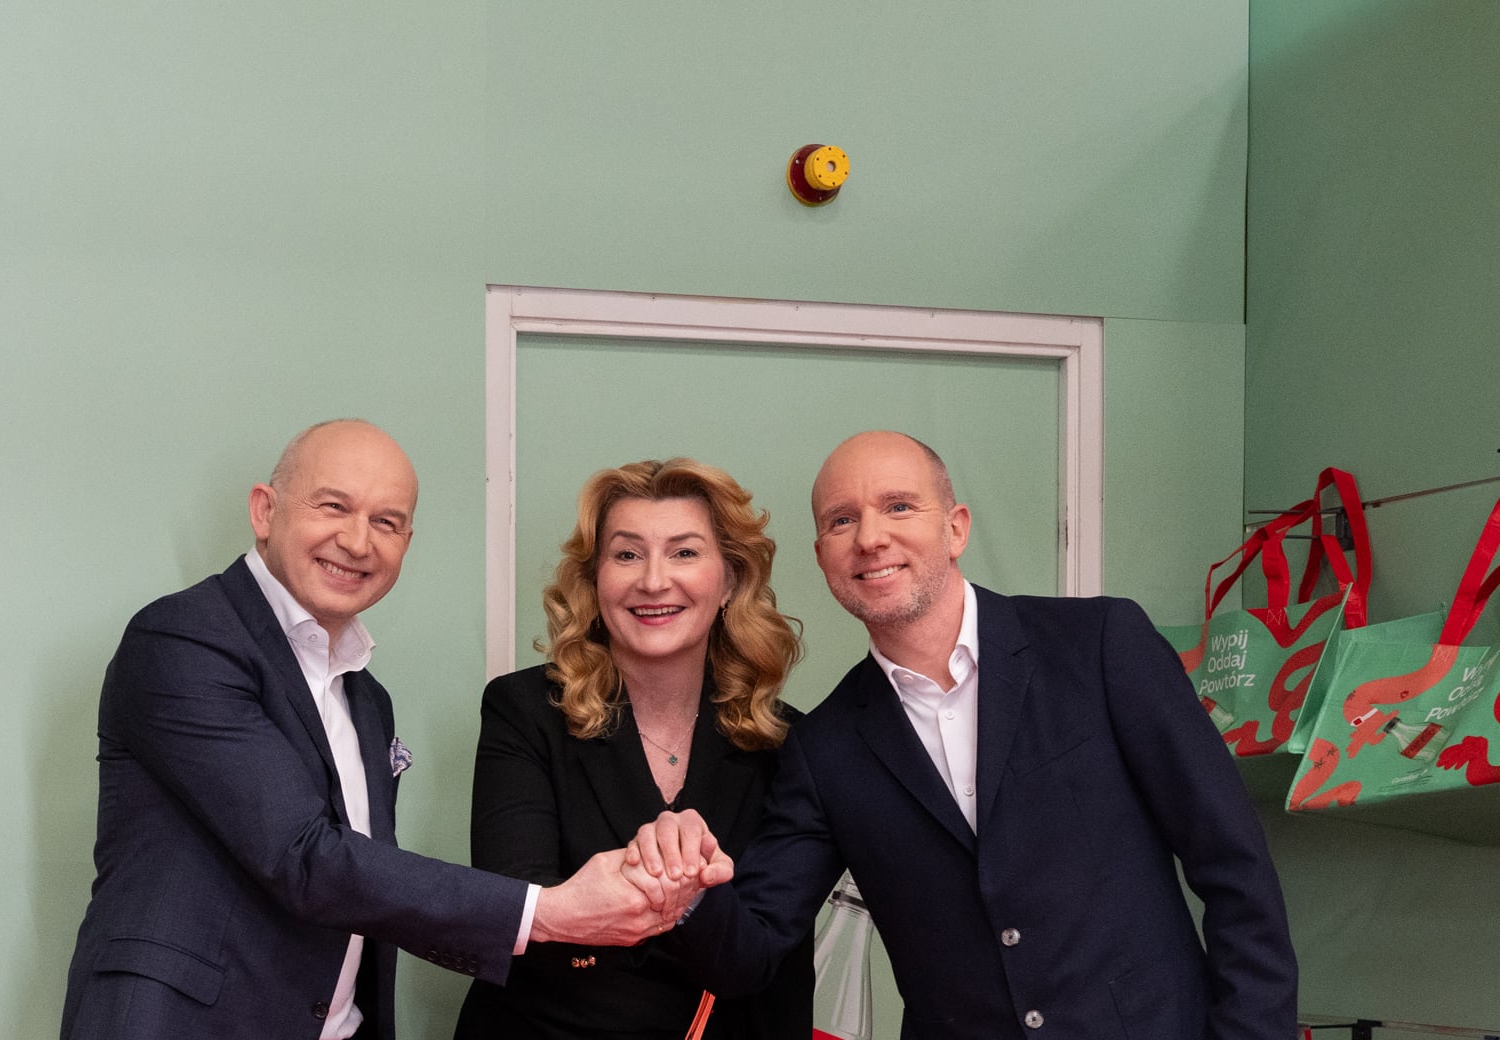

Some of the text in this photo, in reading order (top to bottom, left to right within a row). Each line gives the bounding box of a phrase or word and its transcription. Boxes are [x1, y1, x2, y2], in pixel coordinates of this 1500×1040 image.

[1211, 630, 1248, 652] Wypij
[1208, 650, 1247, 673] Oddaj
[1198, 670, 1255, 695] Powtórz
